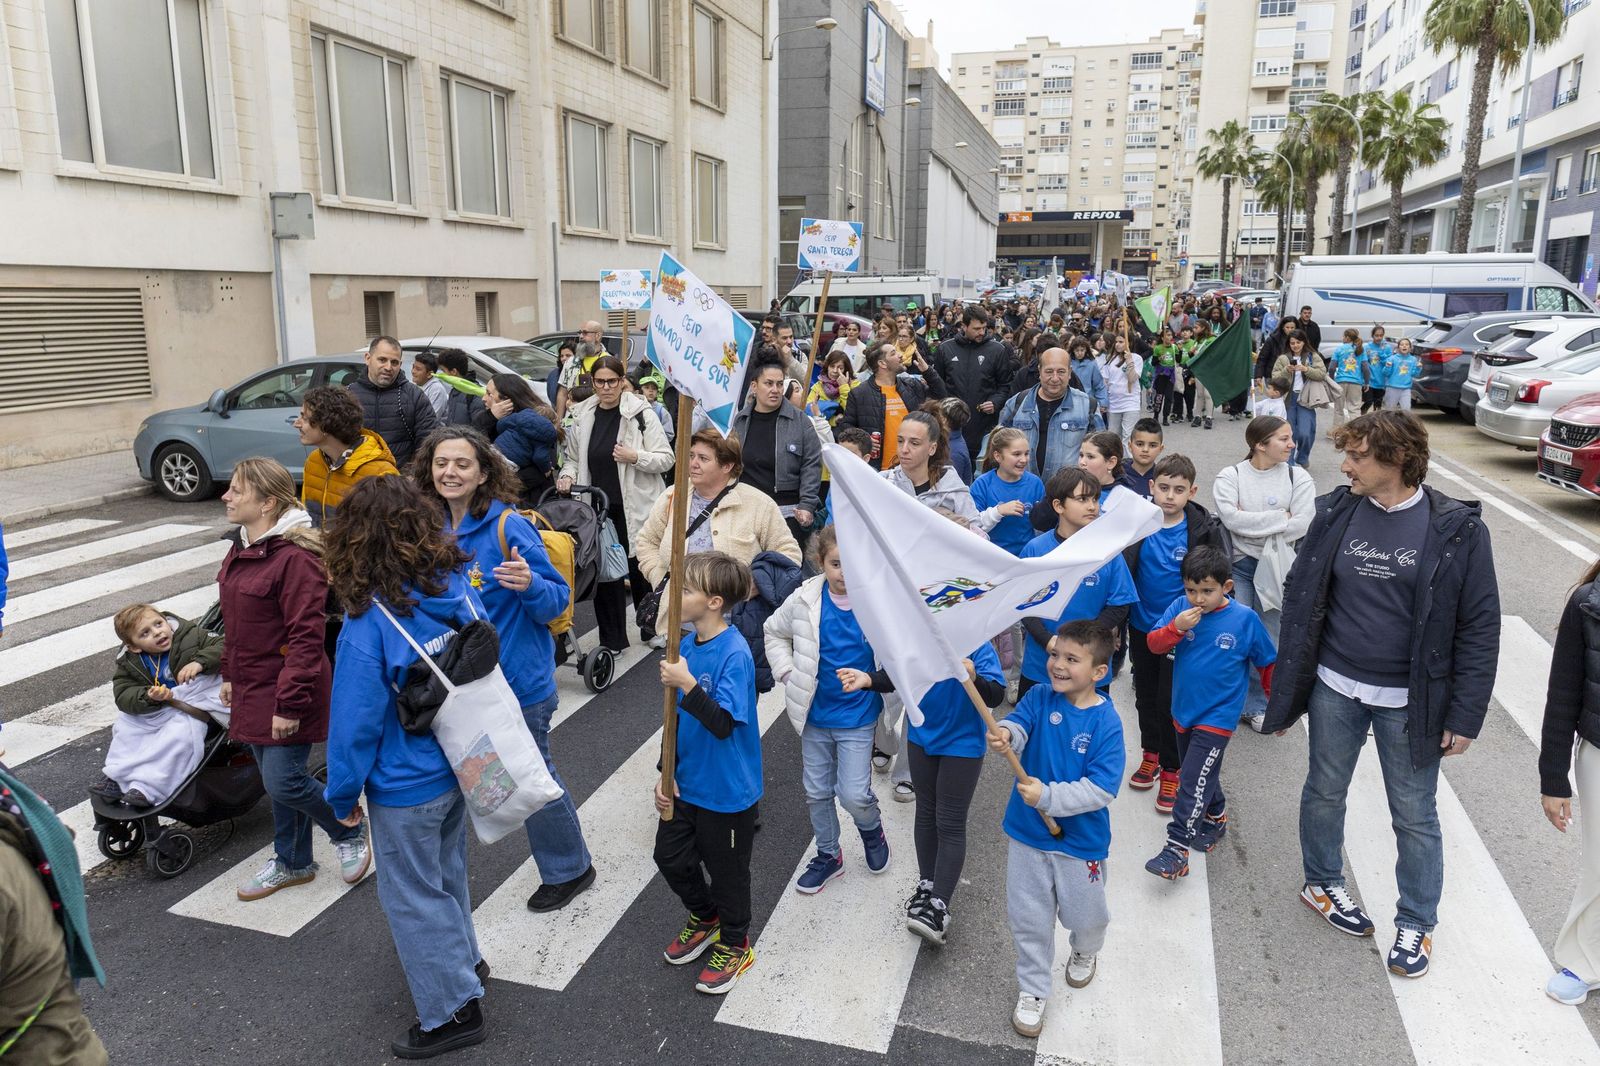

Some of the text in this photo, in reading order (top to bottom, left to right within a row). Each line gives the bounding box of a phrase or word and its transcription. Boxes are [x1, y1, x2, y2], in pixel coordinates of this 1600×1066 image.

[1073, 211, 1121, 220] REPSOL
[824, 234, 837, 242] CEIP
[807, 245, 854, 256] SANTA TERESA
[682, 314, 703, 338] CEIP
[655, 314, 731, 393] CAMPO DEL SUR
[1344, 539, 1417, 567] Scalpers Co.
